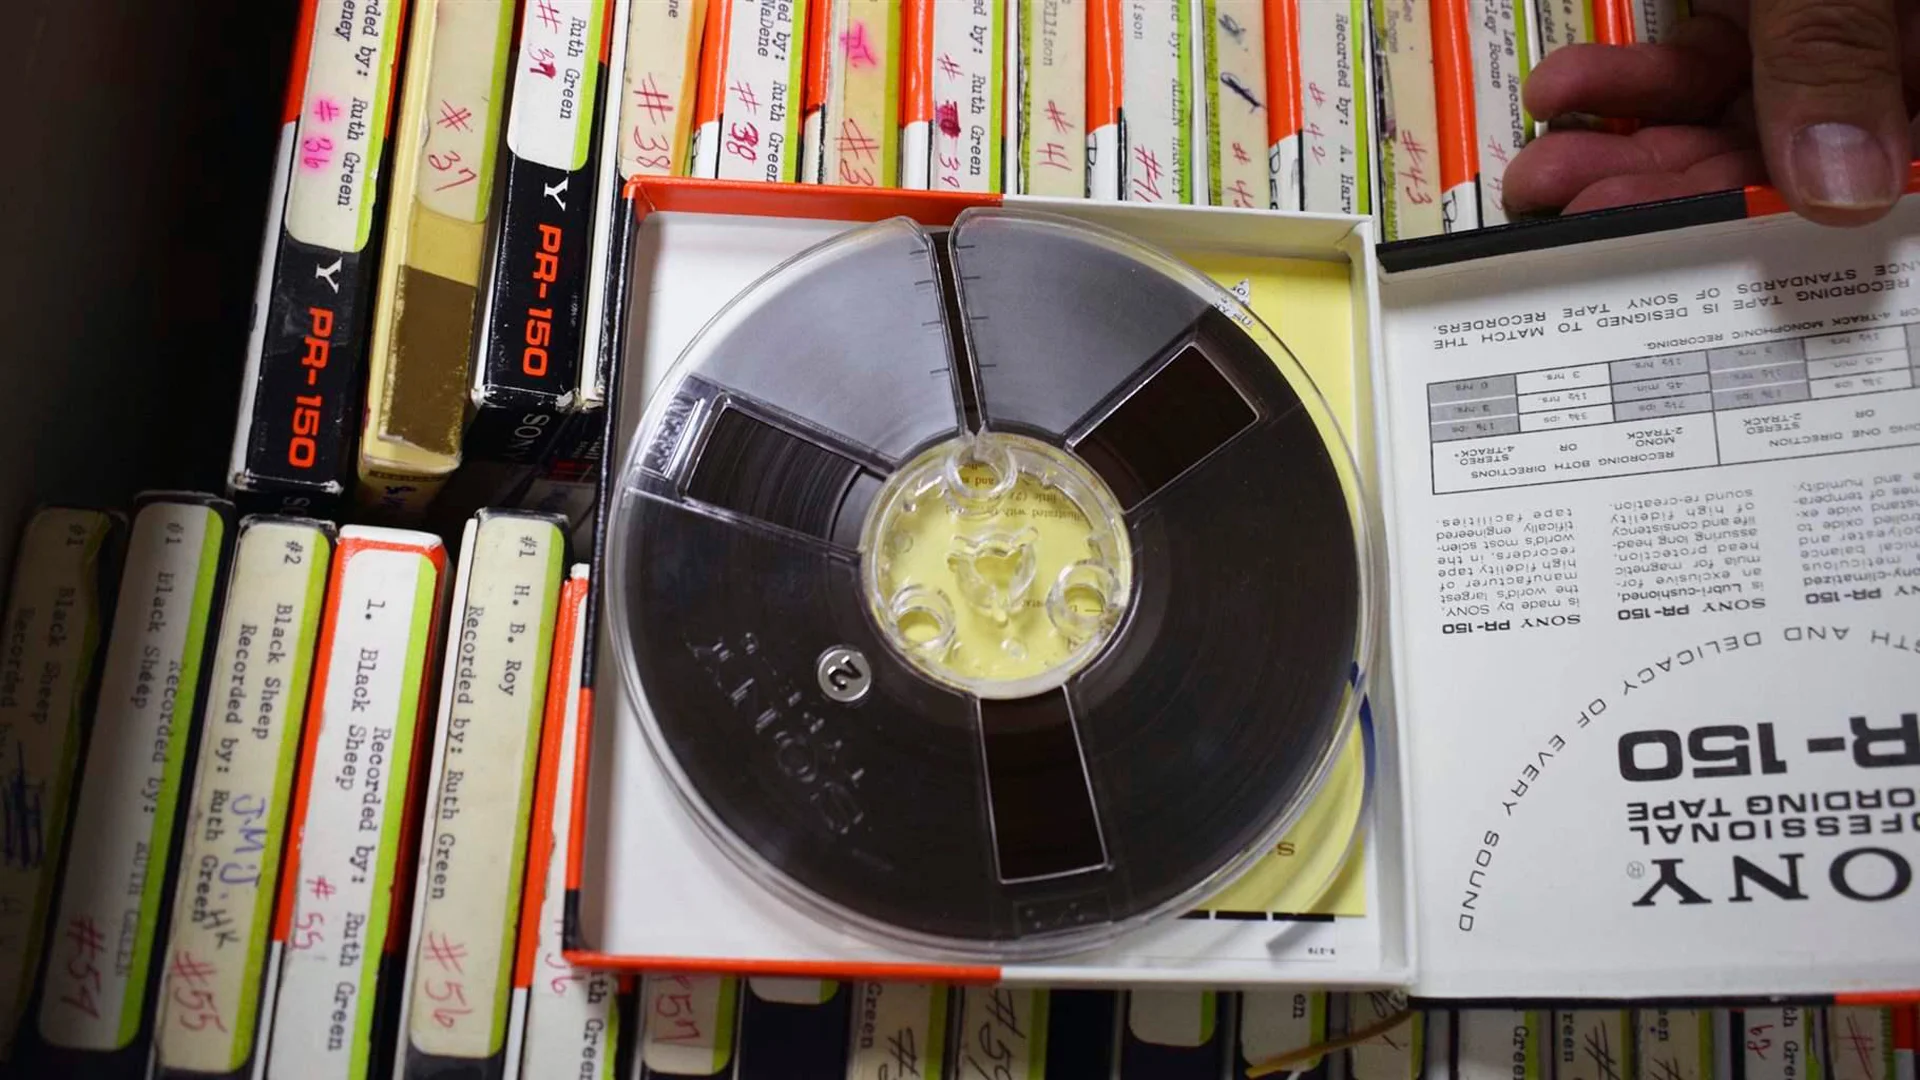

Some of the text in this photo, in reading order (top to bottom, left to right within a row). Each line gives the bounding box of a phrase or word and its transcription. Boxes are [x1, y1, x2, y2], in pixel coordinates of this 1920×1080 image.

[772, 30, 792, 61] by:
[1334, 13, 1351, 88] Recorded
[560, 16, 587, 120] Ruth Green
[1488, 43, 1502, 90] Boone
[769, 80, 788, 122] Ruth
[969, 25, 988, 177] by: Ruth Green
[1503, 28, 1524, 150] Lee Recorded
[337, 44, 377, 206] by: Ruth Green
[1335, 97, 1352, 126] by:
[429, 150, 478, 192] 37
[1339, 145, 1353, 164] A.
[522, 224, 563, 378] PR-150
[1432, 268, 1857, 336] STANDARDS OF SONY TAPE RECORDERS.
[1433, 277, 1910, 351] RECORDING TAPE IS DESIGNED TO MATCH THE
[1730, 320, 1824, 340] MONOPHONIC
[288, 306, 334, 469] PR-150
[1624, 425, 1684, 441] 2-TRACK
[1741, 411, 1802, 428] 2-TRACK
[1745, 421, 1801, 436] STEREO
[1458, 435, 1676, 467] MONO OR STEREO
[1767, 430, 1843, 448] DIRECTION
[1469, 449, 1675, 480] RECORDING BOTH DIRECTIONS
[1704, 488, 1753, 504] sound
[1434, 519, 1574, 542] tifically engineered
[1532, 507, 1573, 521] tape
[1609, 503, 1724, 526] high fidelity
[1610, 520, 1698, 538] consistency
[284, 539, 305, 566] #2
[1482, 532, 1576, 550] world's most
[1656, 527, 1758, 547] assuring long
[1716, 540, 1760, 555] head
[1436, 555, 1463, 567] the
[1436, 557, 1577, 579] high fidelity tape
[1613, 560, 1683, 578] magnetic
[1654, 569, 1731, 587] exclusive
[1439, 583, 1579, 605] the world's largest
[1464, 571, 1578, 590] manufacturer
[1804, 587, 1882, 605] PR-150
[48, 585, 77, 648] Black
[130, 521, 186, 711] #1 Black Sheep
[498, 535, 538, 697] #1 H. B. Roy
[1496, 598, 1561, 613] made by
[1616, 597, 1767, 622] SONY PR-150
[267, 603, 294, 665] Black
[1441, 613, 1582, 635] SONY PR-150
[30, 660, 62, 726] Sheep
[351, 647, 379, 714] Black
[151, 659, 188, 765] Recorded
[252, 675, 282, 741] Sheep
[335, 723, 367, 791] Sheep
[431, 605, 485, 900] Recorded by: Ruth Green
[191, 622, 258, 924] Recorded by: Ruth Green
[1457, 625, 1850, 933] AND DELICACY OF EVERY SOUND
[140, 776, 162, 814] by:
[1626, 786, 1920, 822] ORDING TAPE
[328, 726, 392, 1052] Recorded by: Ruth Green
[860, 981, 884, 1049] Green
[1512, 1025, 1531, 1080] Gree
